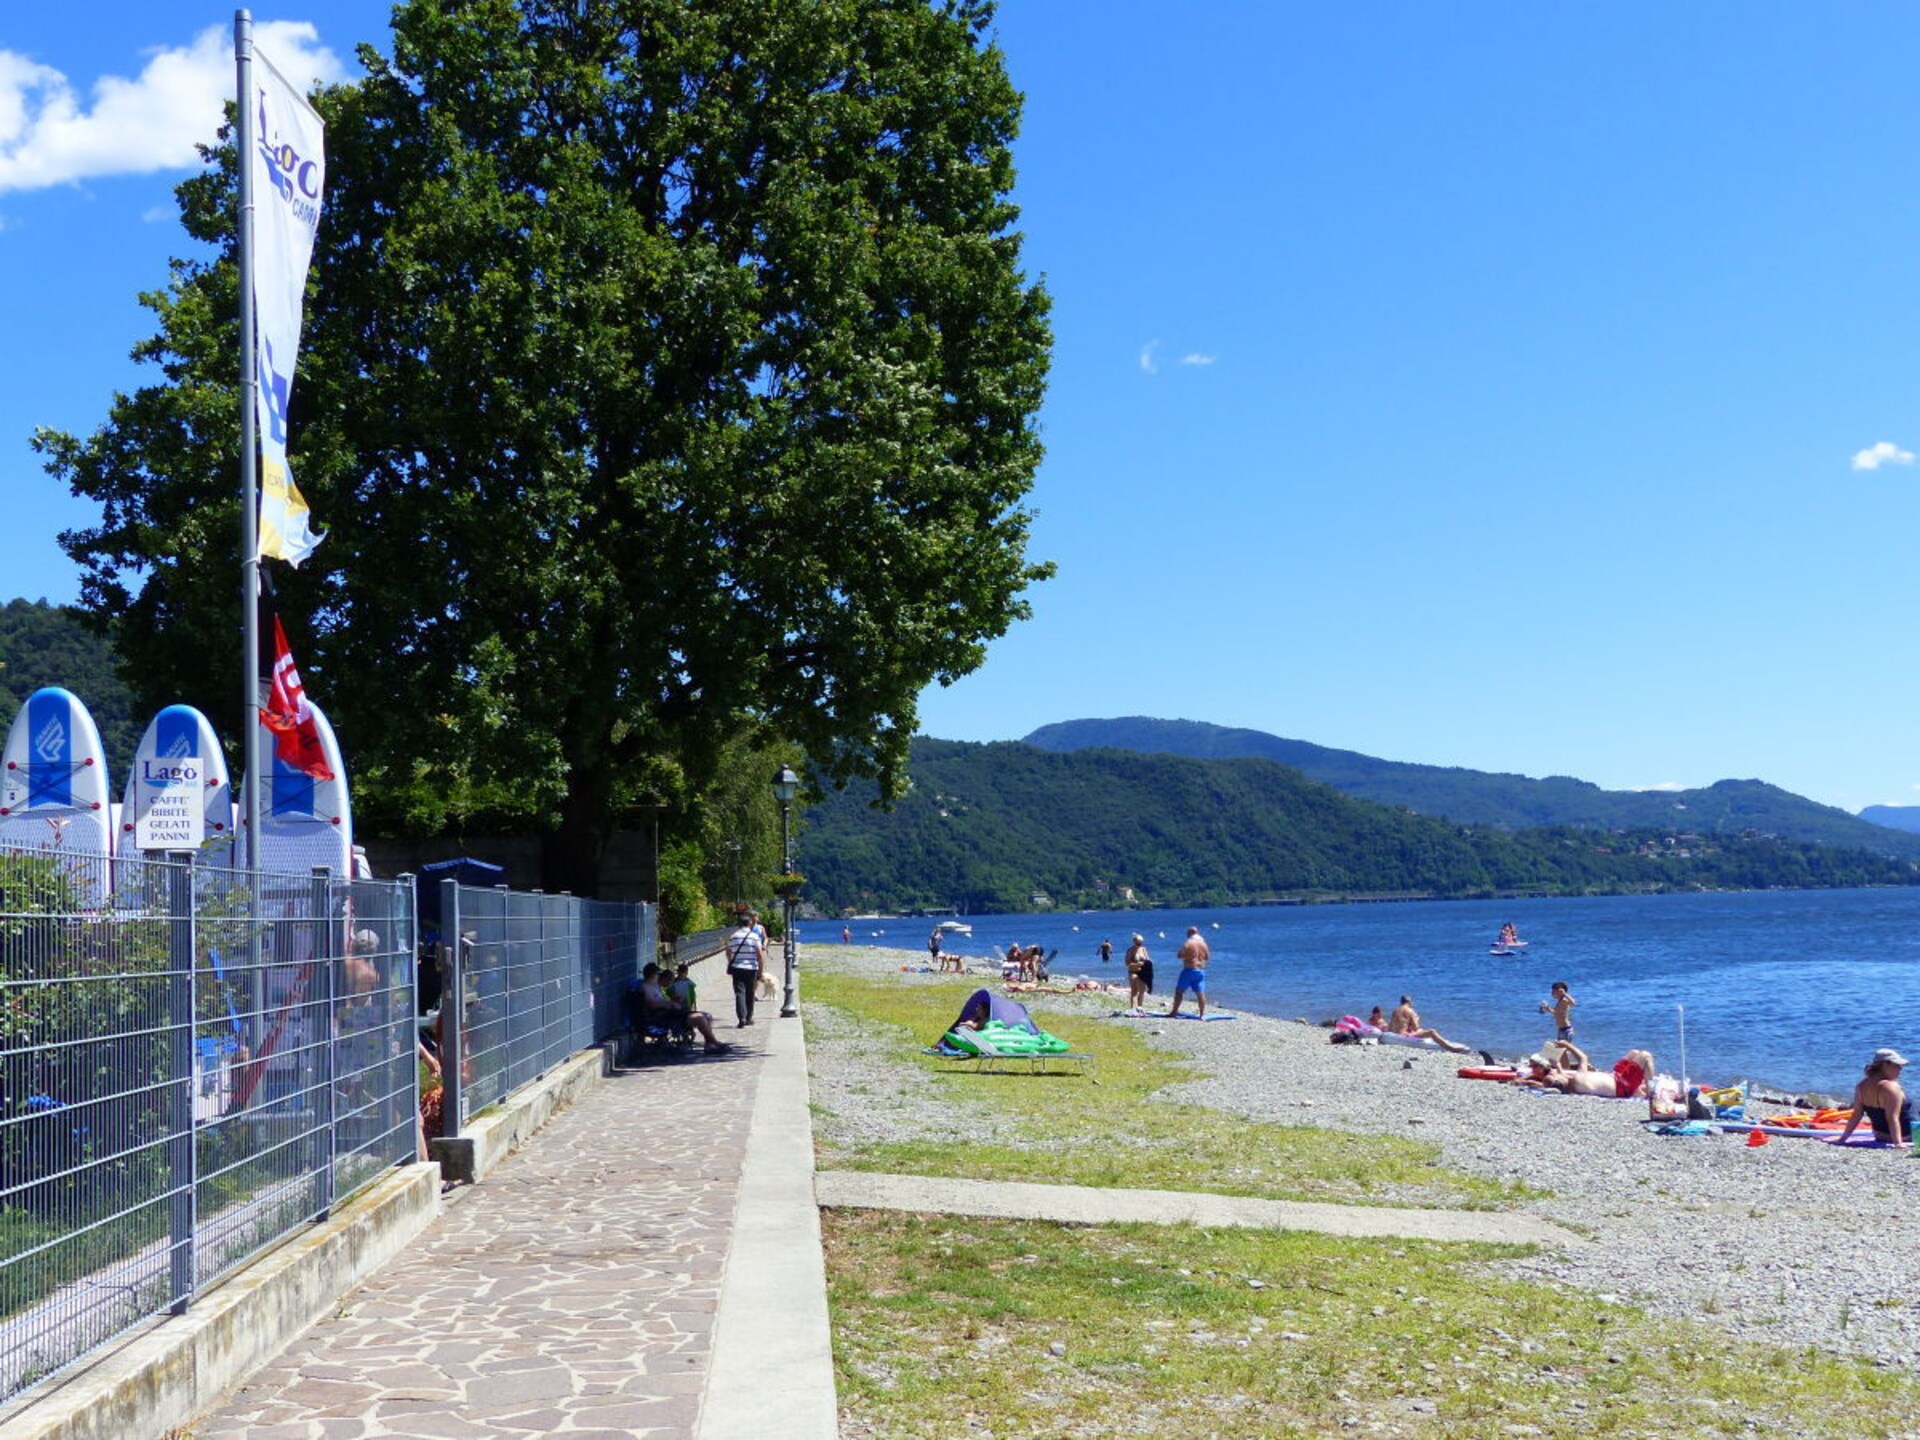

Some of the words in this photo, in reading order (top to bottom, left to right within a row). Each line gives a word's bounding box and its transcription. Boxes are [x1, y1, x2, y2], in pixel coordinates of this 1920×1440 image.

[151, 808, 189, 817] BIBITE
[149, 820, 191, 829] GELATI
[150, 832, 190, 841] PANINI
